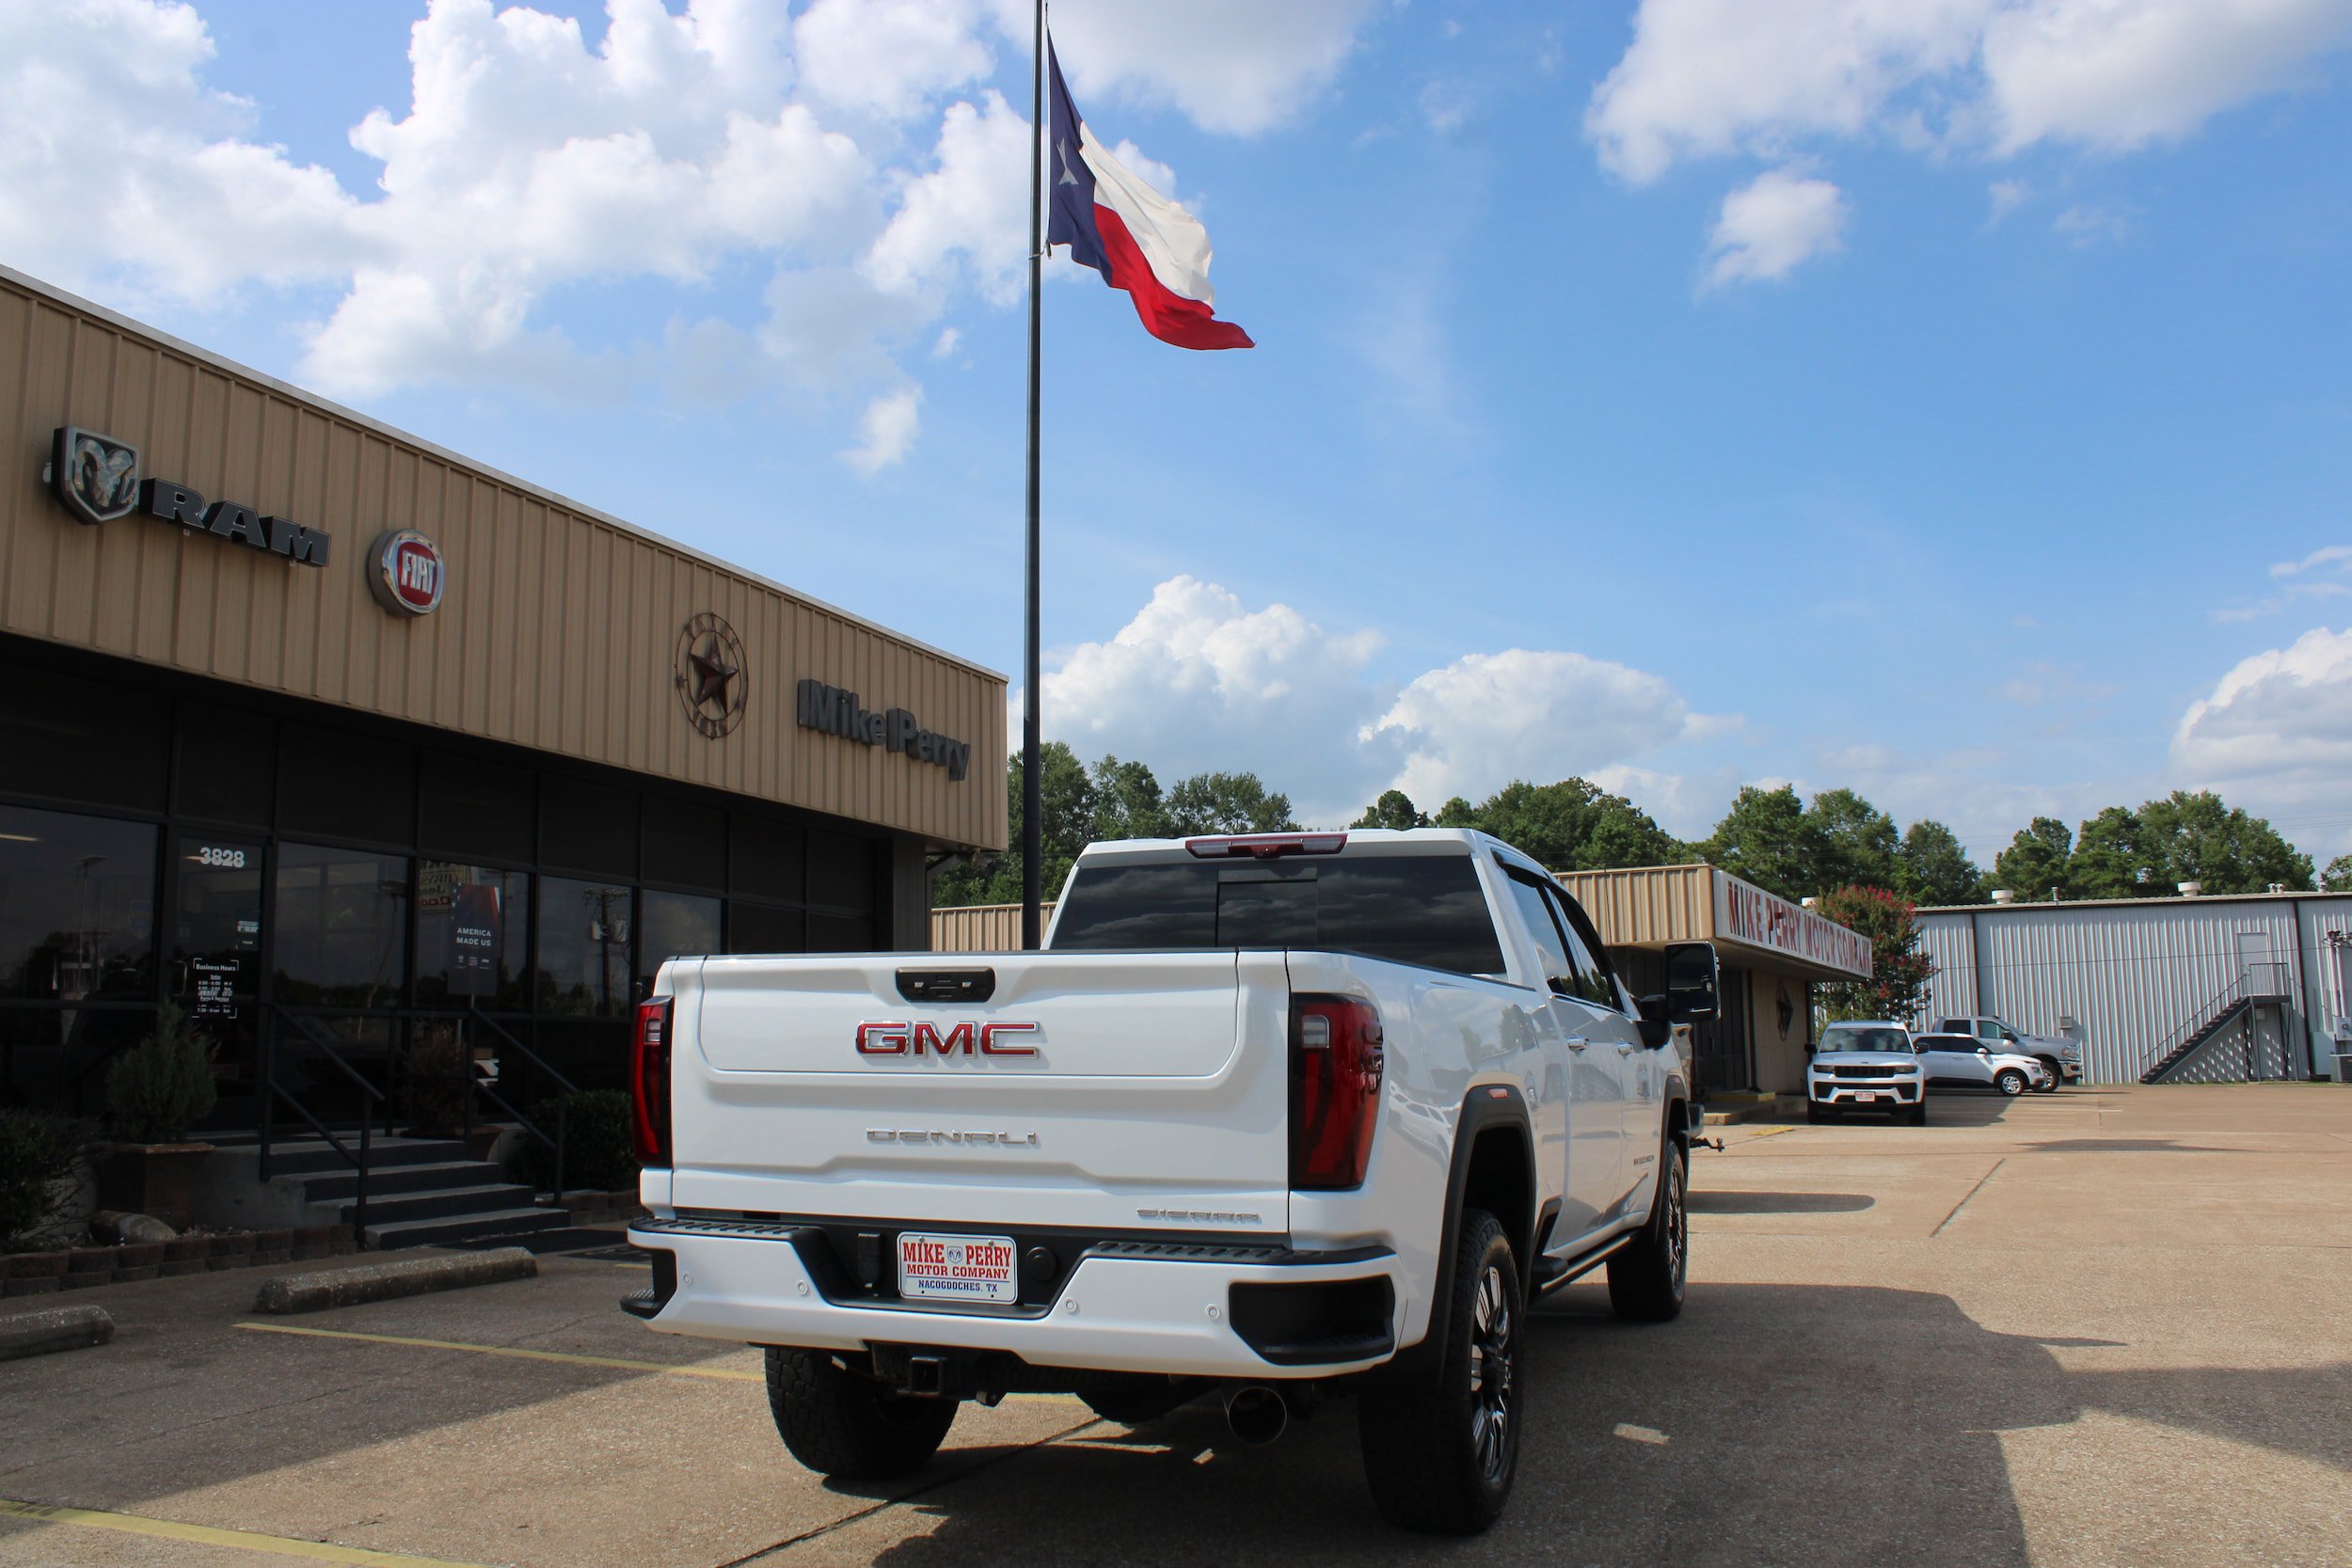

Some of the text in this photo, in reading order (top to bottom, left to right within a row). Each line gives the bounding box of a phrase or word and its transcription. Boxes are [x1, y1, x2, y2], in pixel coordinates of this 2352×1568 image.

[151, 477, 331, 566] RAM
[401, 549, 436, 594] FIAT
[797, 678, 971, 782] Mike Perry
[199, 847, 245, 868] 3828
[456, 927, 492, 938] AMERICA
[1727, 880, 1871, 974] MIKE PERRY MOTOR COMPANY
[456, 936, 492, 947] MADE US
[855, 1022, 1040, 1058] GMC
[866, 1127, 1036, 1145] DENALI
[1136, 1208, 1259, 1220] SIERRA
[902, 1242, 1011, 1267] MIKE PERRY
[907, 1263, 1009, 1279] MOTOR COMPANY
[918, 1279, 997, 1292] NACOGDOCHES, TX
